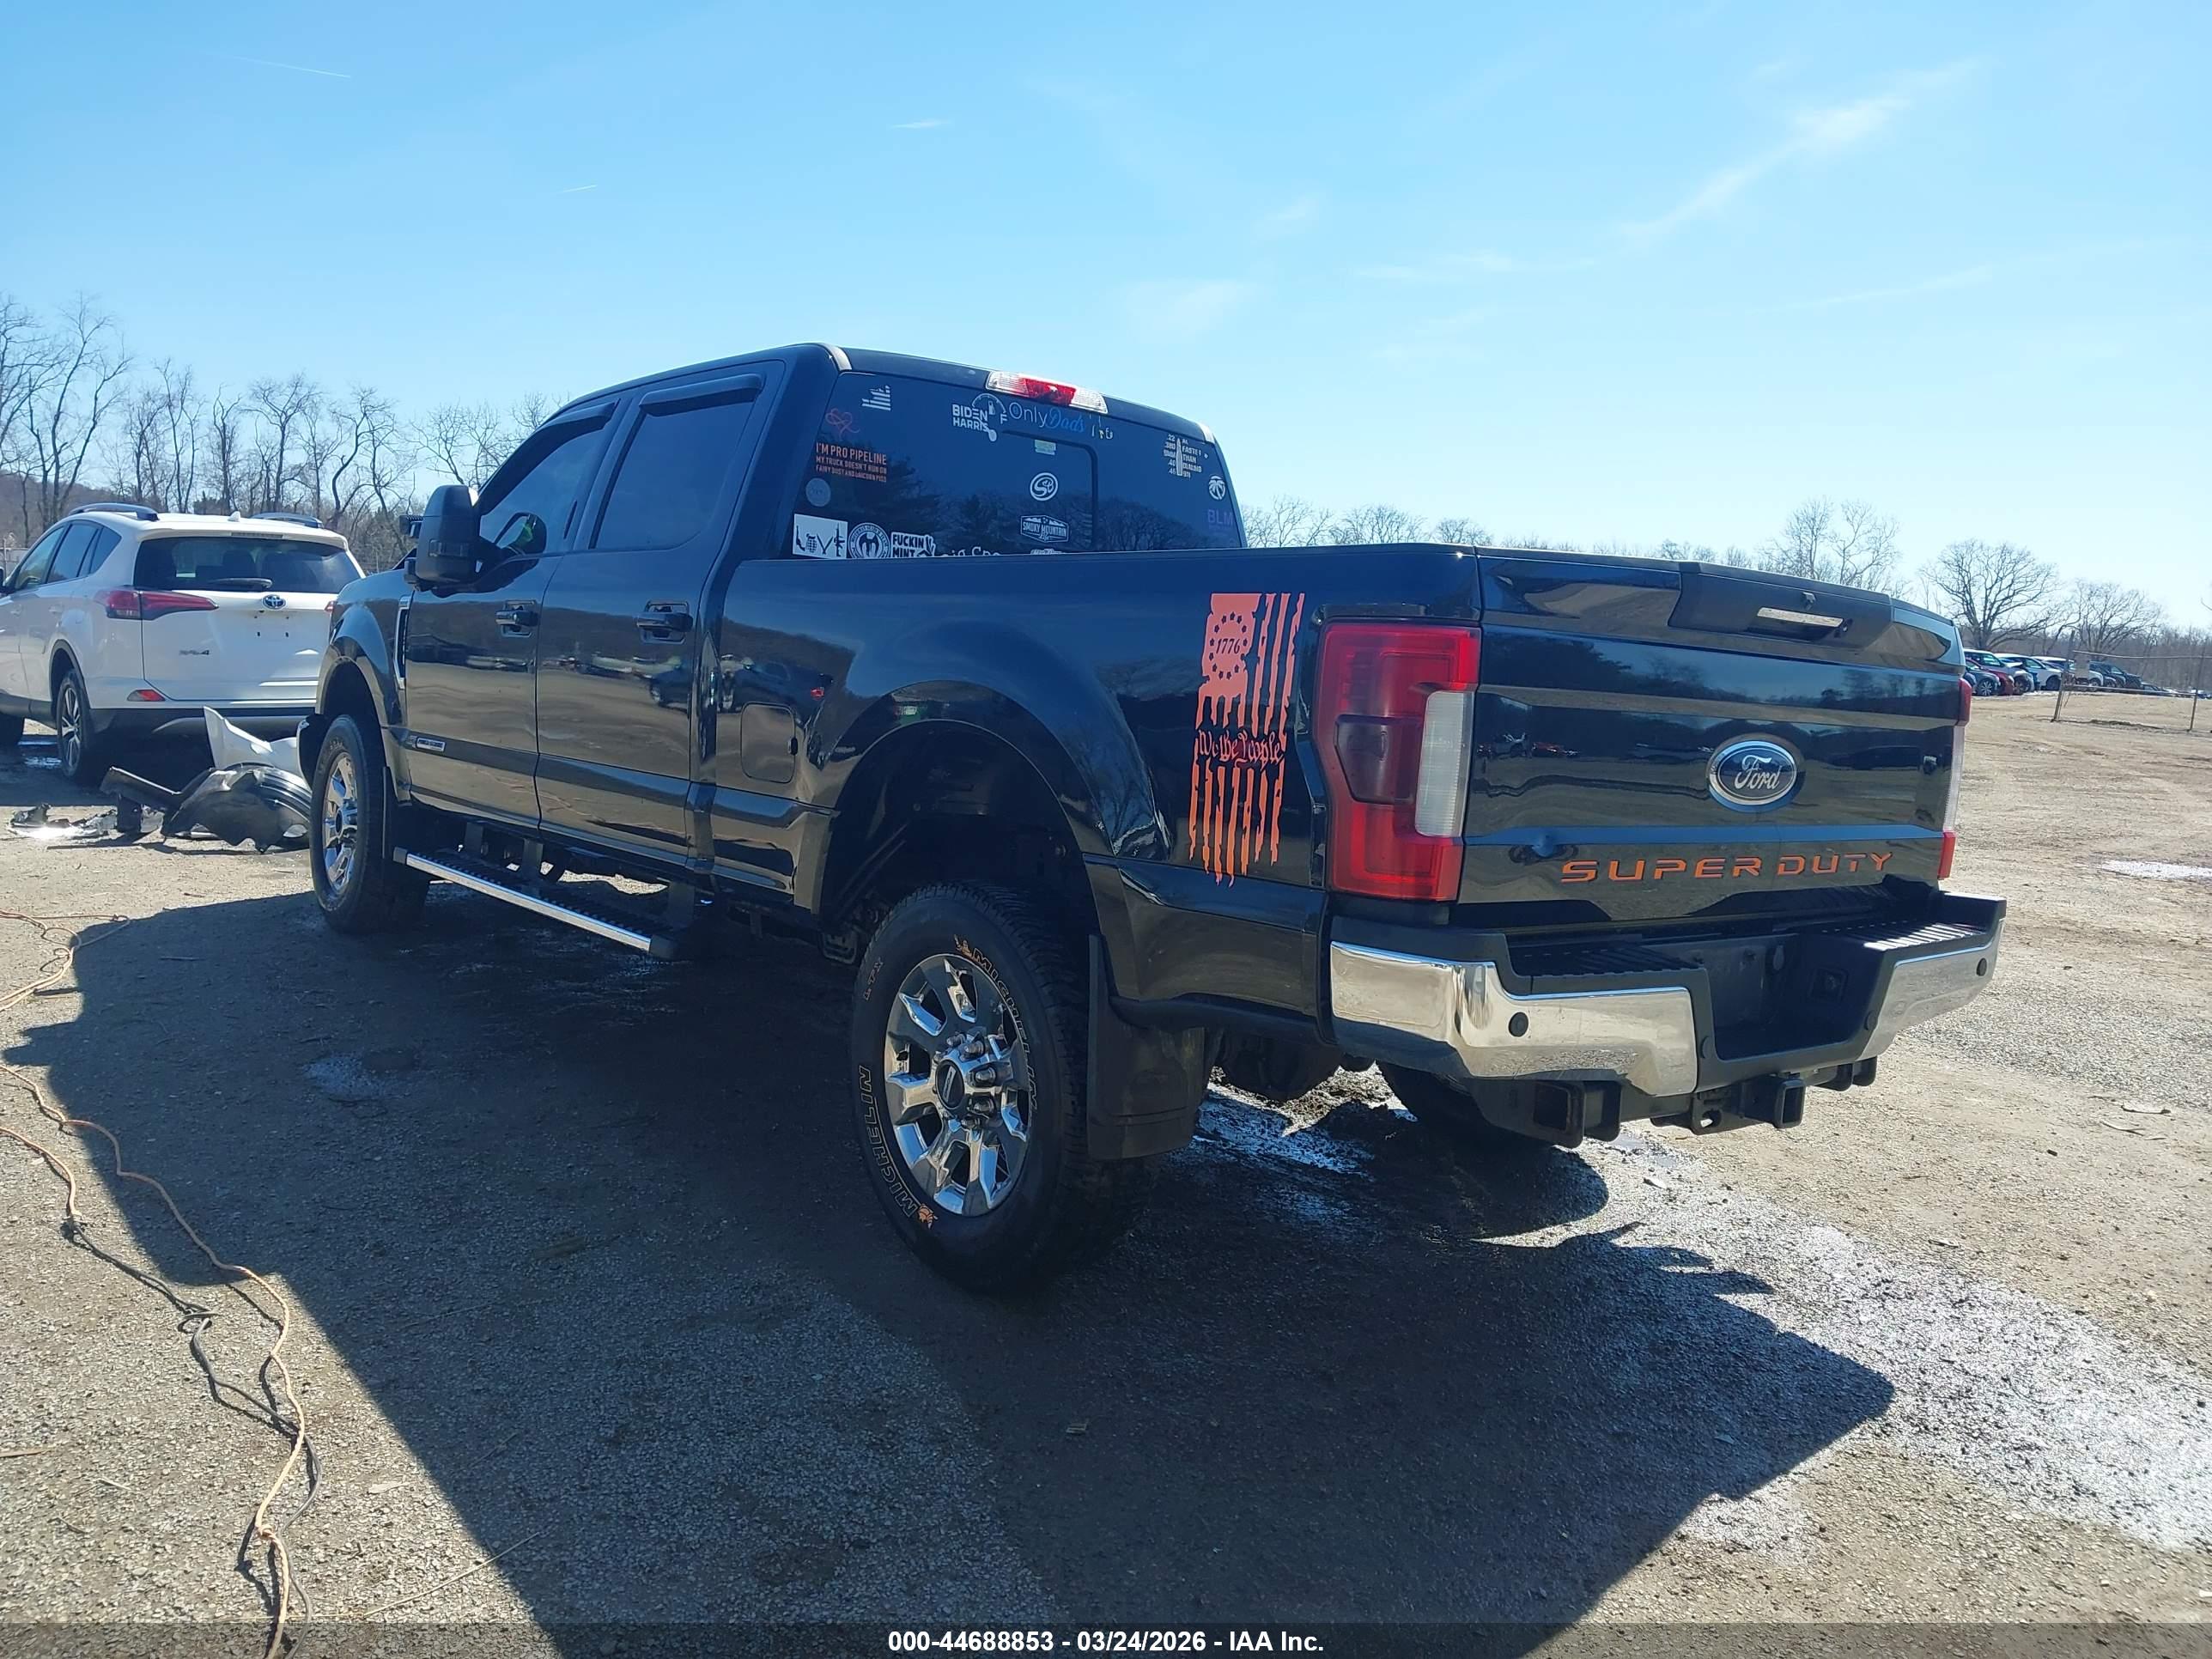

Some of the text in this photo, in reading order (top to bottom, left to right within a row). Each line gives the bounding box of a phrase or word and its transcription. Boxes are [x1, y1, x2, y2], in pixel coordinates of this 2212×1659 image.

[951, 404, 988, 421] BIDEN
[953, 417, 989, 433] HARRIS
[816, 441, 887, 465] I'M PRO PIPELINE
[816, 455, 824, 464] MY
[826, 457, 843, 465] TRUCK
[1208, 508, 1233, 526] BLM
[893, 534, 925, 550] FUCKIN
[1216, 638, 1241, 654] 1776
[1734, 754, 1784, 791] Ford
[1560, 851, 1893, 884] SUPER DUTY
[859, 1065, 920, 1218] MICHELIN
